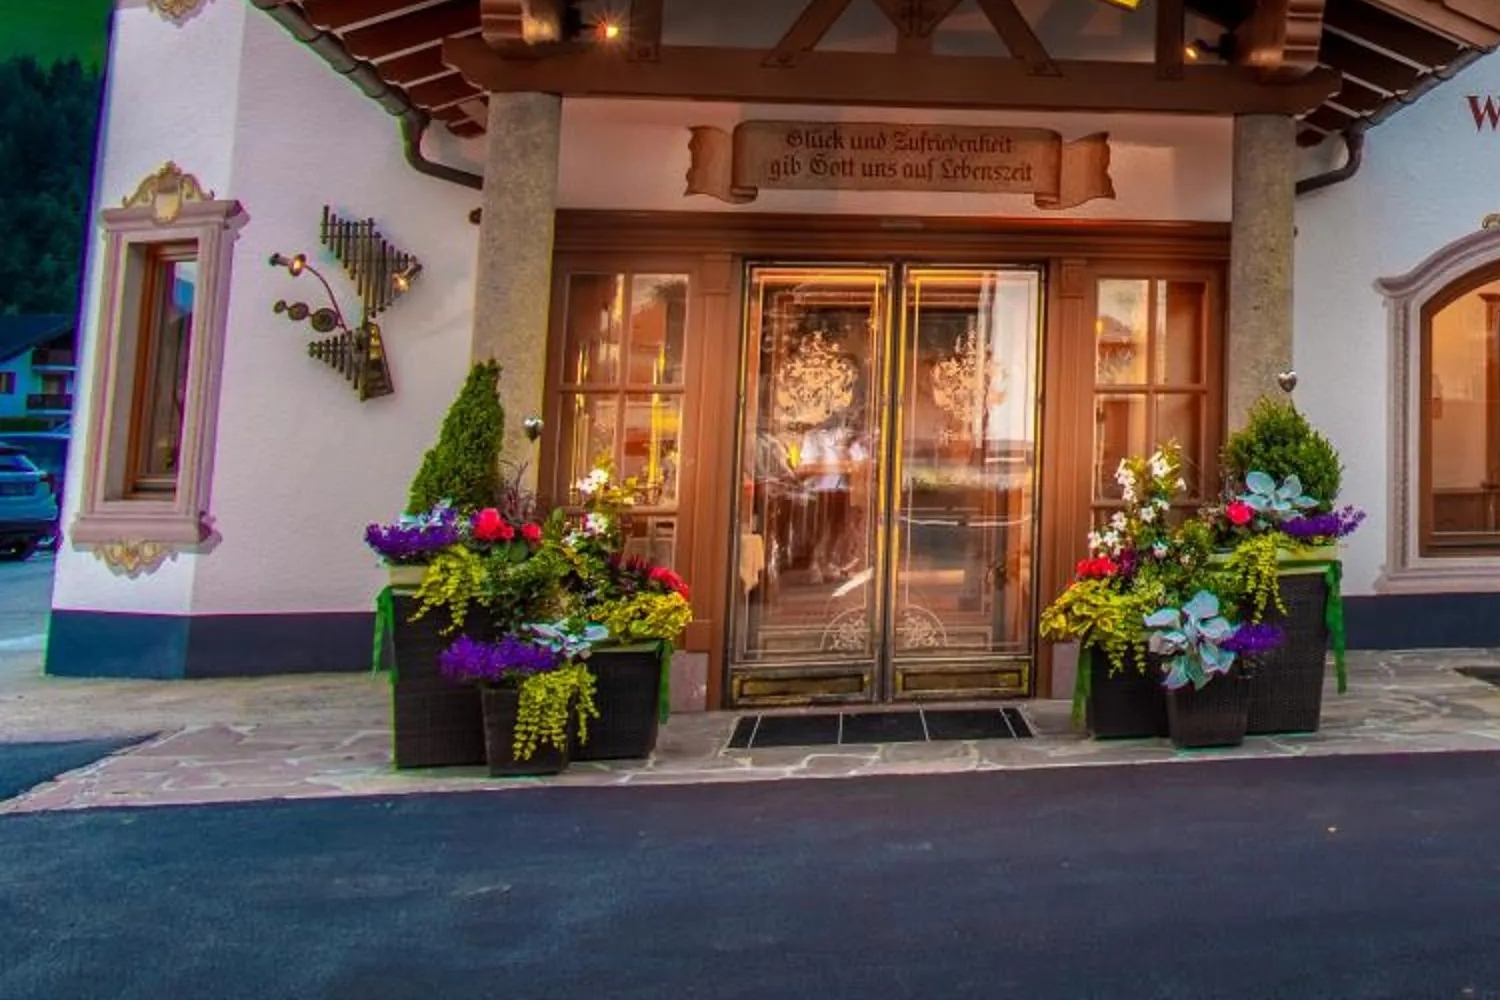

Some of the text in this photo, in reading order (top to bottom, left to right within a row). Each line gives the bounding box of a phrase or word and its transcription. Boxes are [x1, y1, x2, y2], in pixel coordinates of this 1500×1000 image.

[850, 131, 889, 151] und
[893, 130, 1016, 156] Zufriedenheit
[768, 153, 1034, 184] gib Gott uns auf Lebenszeit
